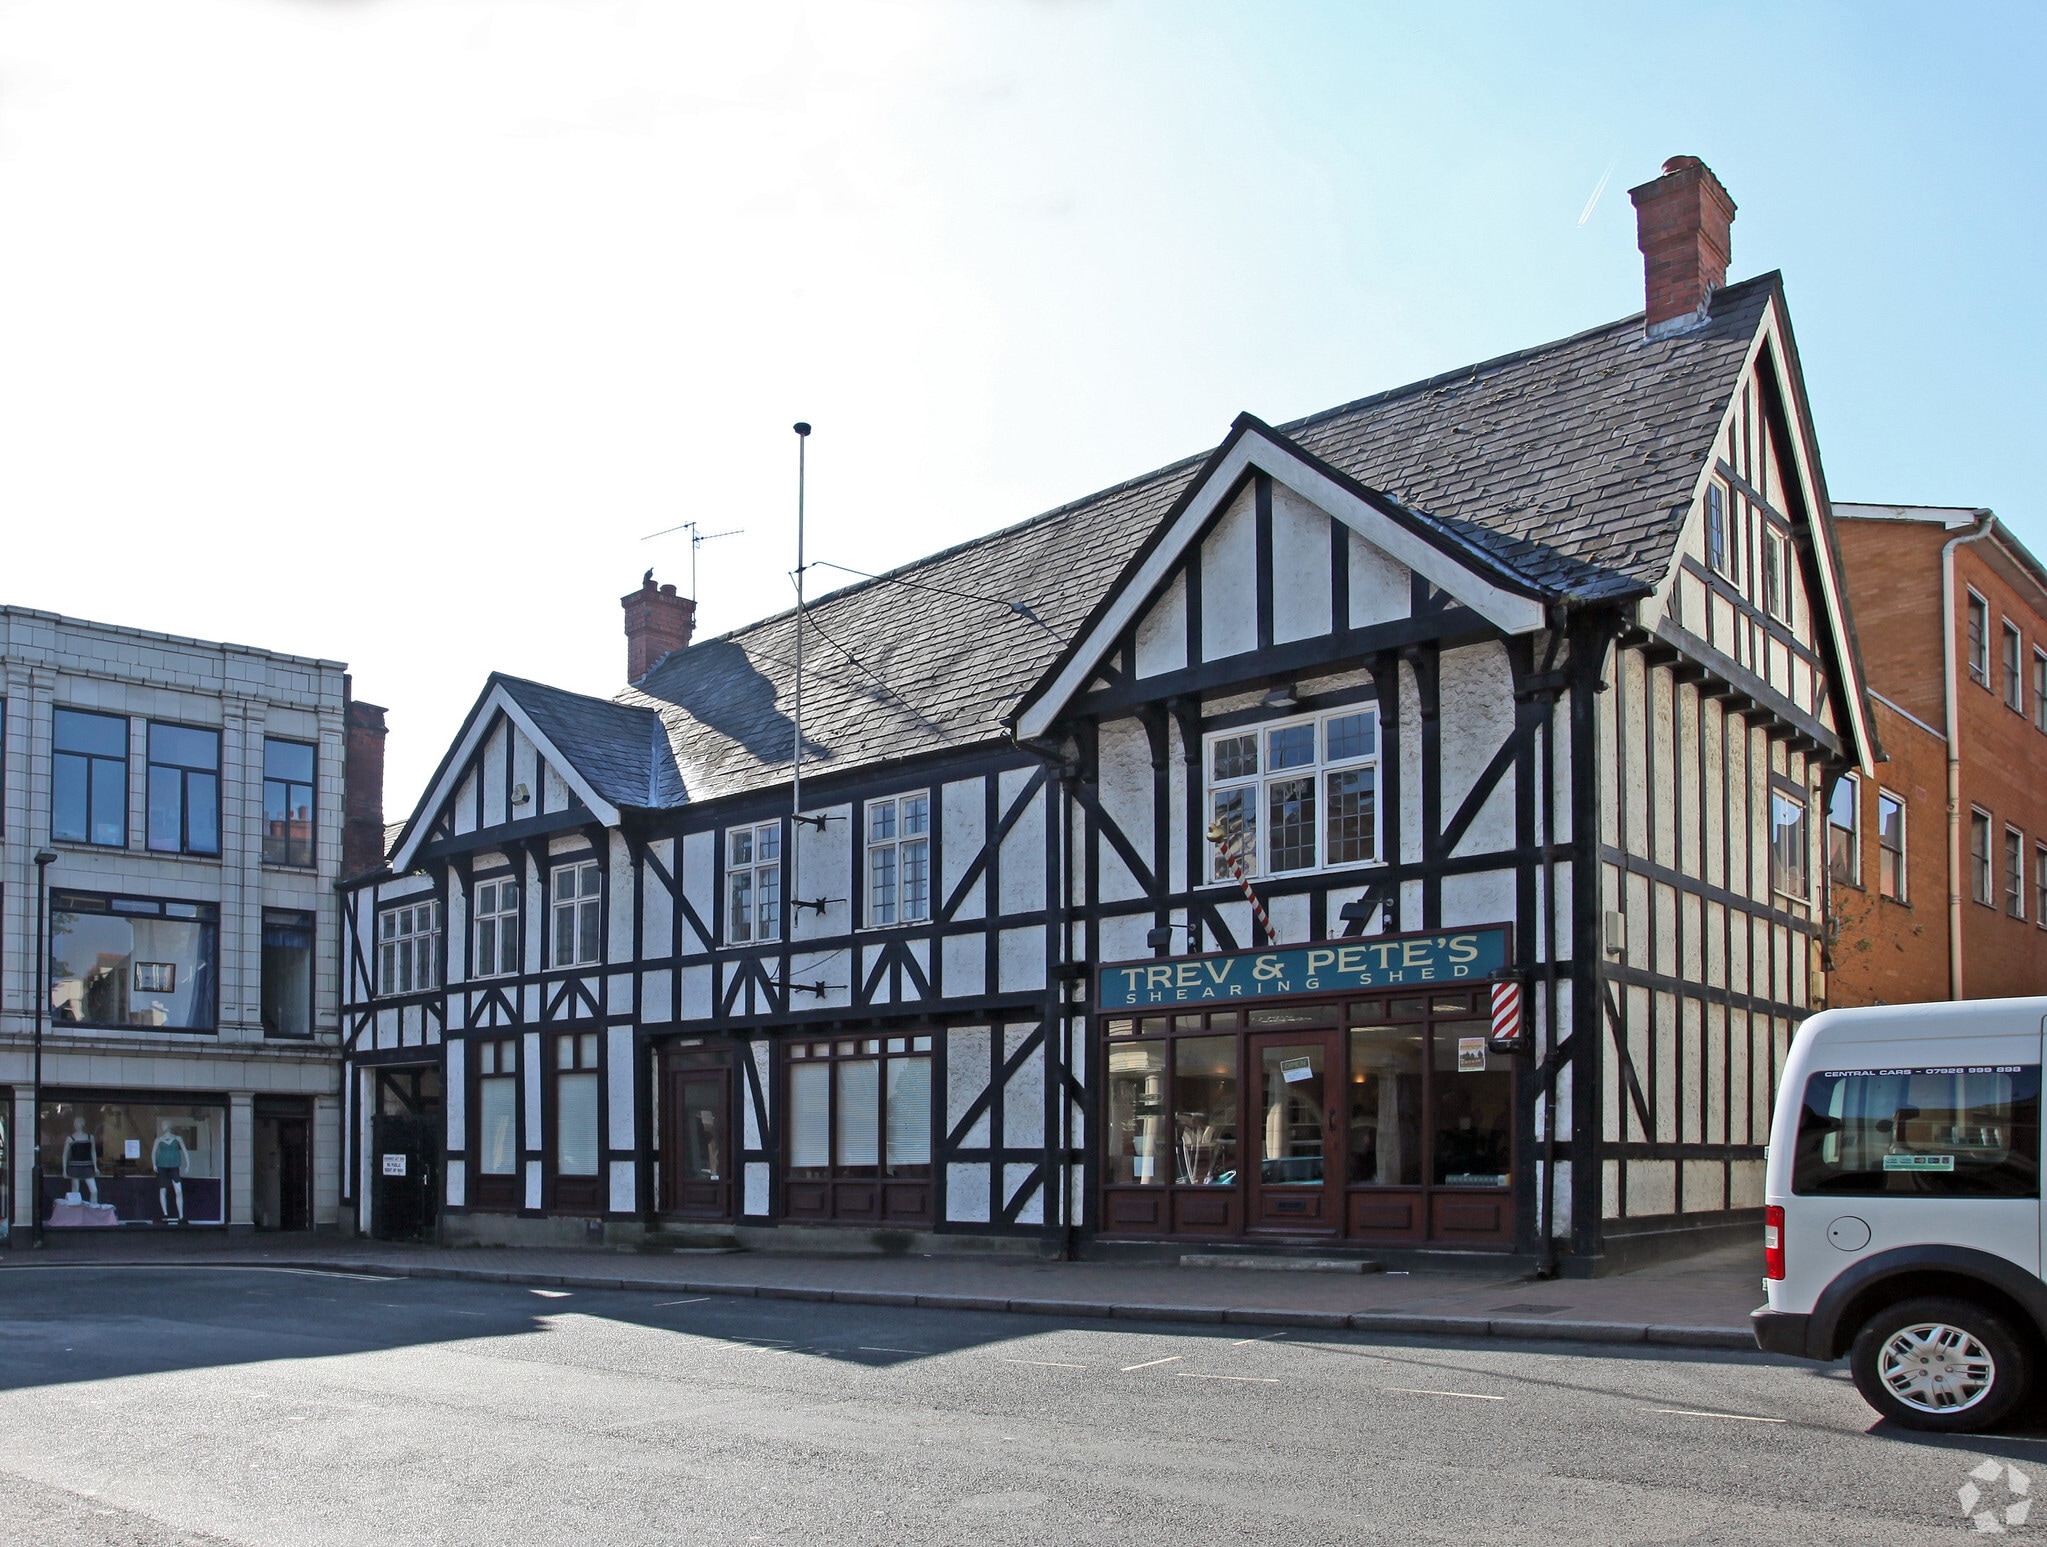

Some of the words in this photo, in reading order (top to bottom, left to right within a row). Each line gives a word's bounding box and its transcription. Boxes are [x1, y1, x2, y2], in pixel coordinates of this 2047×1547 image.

[1120, 959, 1235, 991] TREV
[1252, 954, 1285, 981] &
[1306, 935, 1478, 976] PETE'S
[1126, 978, 1320, 1004] SHEARING
[1359, 965, 1469, 985] SHED
[1284, 1059, 1308, 1070] OPEN
